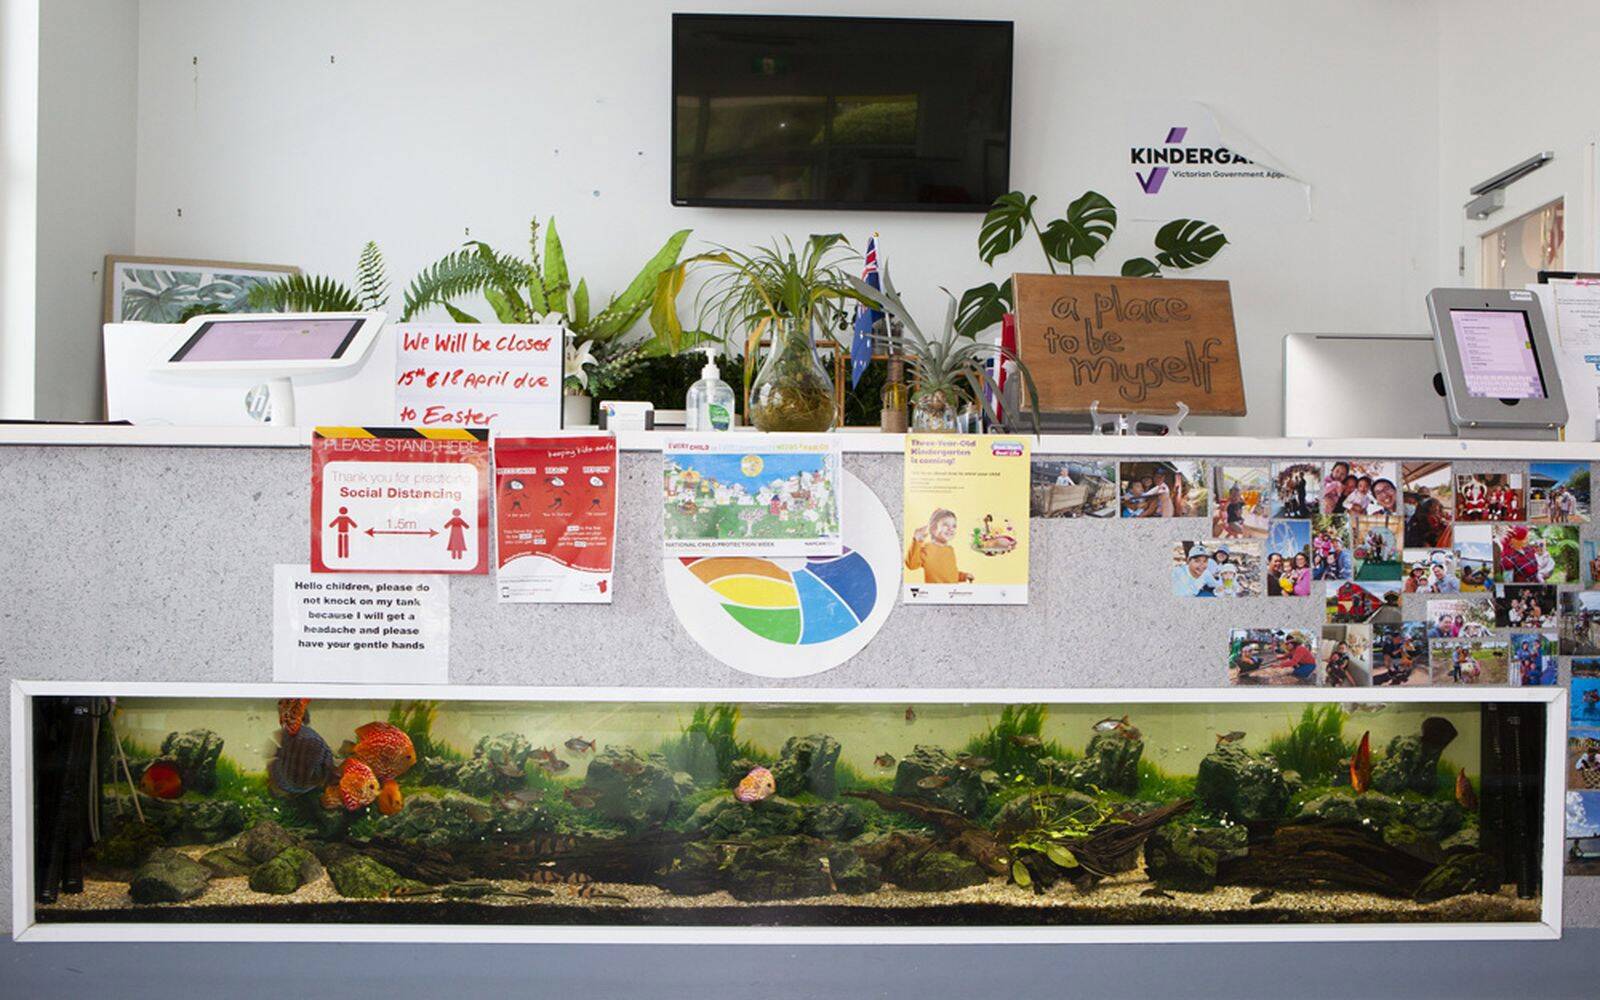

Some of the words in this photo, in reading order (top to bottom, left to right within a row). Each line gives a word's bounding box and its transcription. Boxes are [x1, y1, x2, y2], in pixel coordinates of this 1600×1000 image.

[1130, 148, 1254, 164] KINDERGA
[1052, 296, 1080, 322] a
[1095, 284, 1191, 329] place
[403, 332, 430, 352] We
[434, 332, 468, 352] Will
[472, 332, 492, 352] be
[1044, 326, 1079, 354] to
[1085, 318, 1125, 355] be
[1069, 338, 1222, 403] myself
[441, 368, 464, 387] 18
[464, 371, 510, 390] April
[513, 372, 549, 389] due
[400, 406, 417, 423] to
[422, 406, 500, 426] Easter
[322, 438, 381, 452] PLEASE
[384, 438, 434, 452] STAND
[911, 448, 971, 456] Kindergarten
[919, 458, 956, 466] coming!
[331, 471, 368, 482] Thank
[370, 474, 392, 486] you
[395, 472, 411, 483] for
[340, 486, 382, 498] Social
[387, 487, 462, 502] Distancing
[386, 518, 417, 530] 1.5m
[295, 581, 322, 590] Hello
[326, 582, 373, 592] children,
[376, 583, 412, 593] please
[324, 597, 356, 605] knock
[376, 599, 392, 607] my
[308, 611, 353, 620] because
[387, 613, 404, 622] get
[304, 625, 356, 634] headache
[383, 626, 419, 636] please
[327, 642, 350, 650] your
[353, 641, 388, 650] gentle
[391, 641, 425, 650] hands
